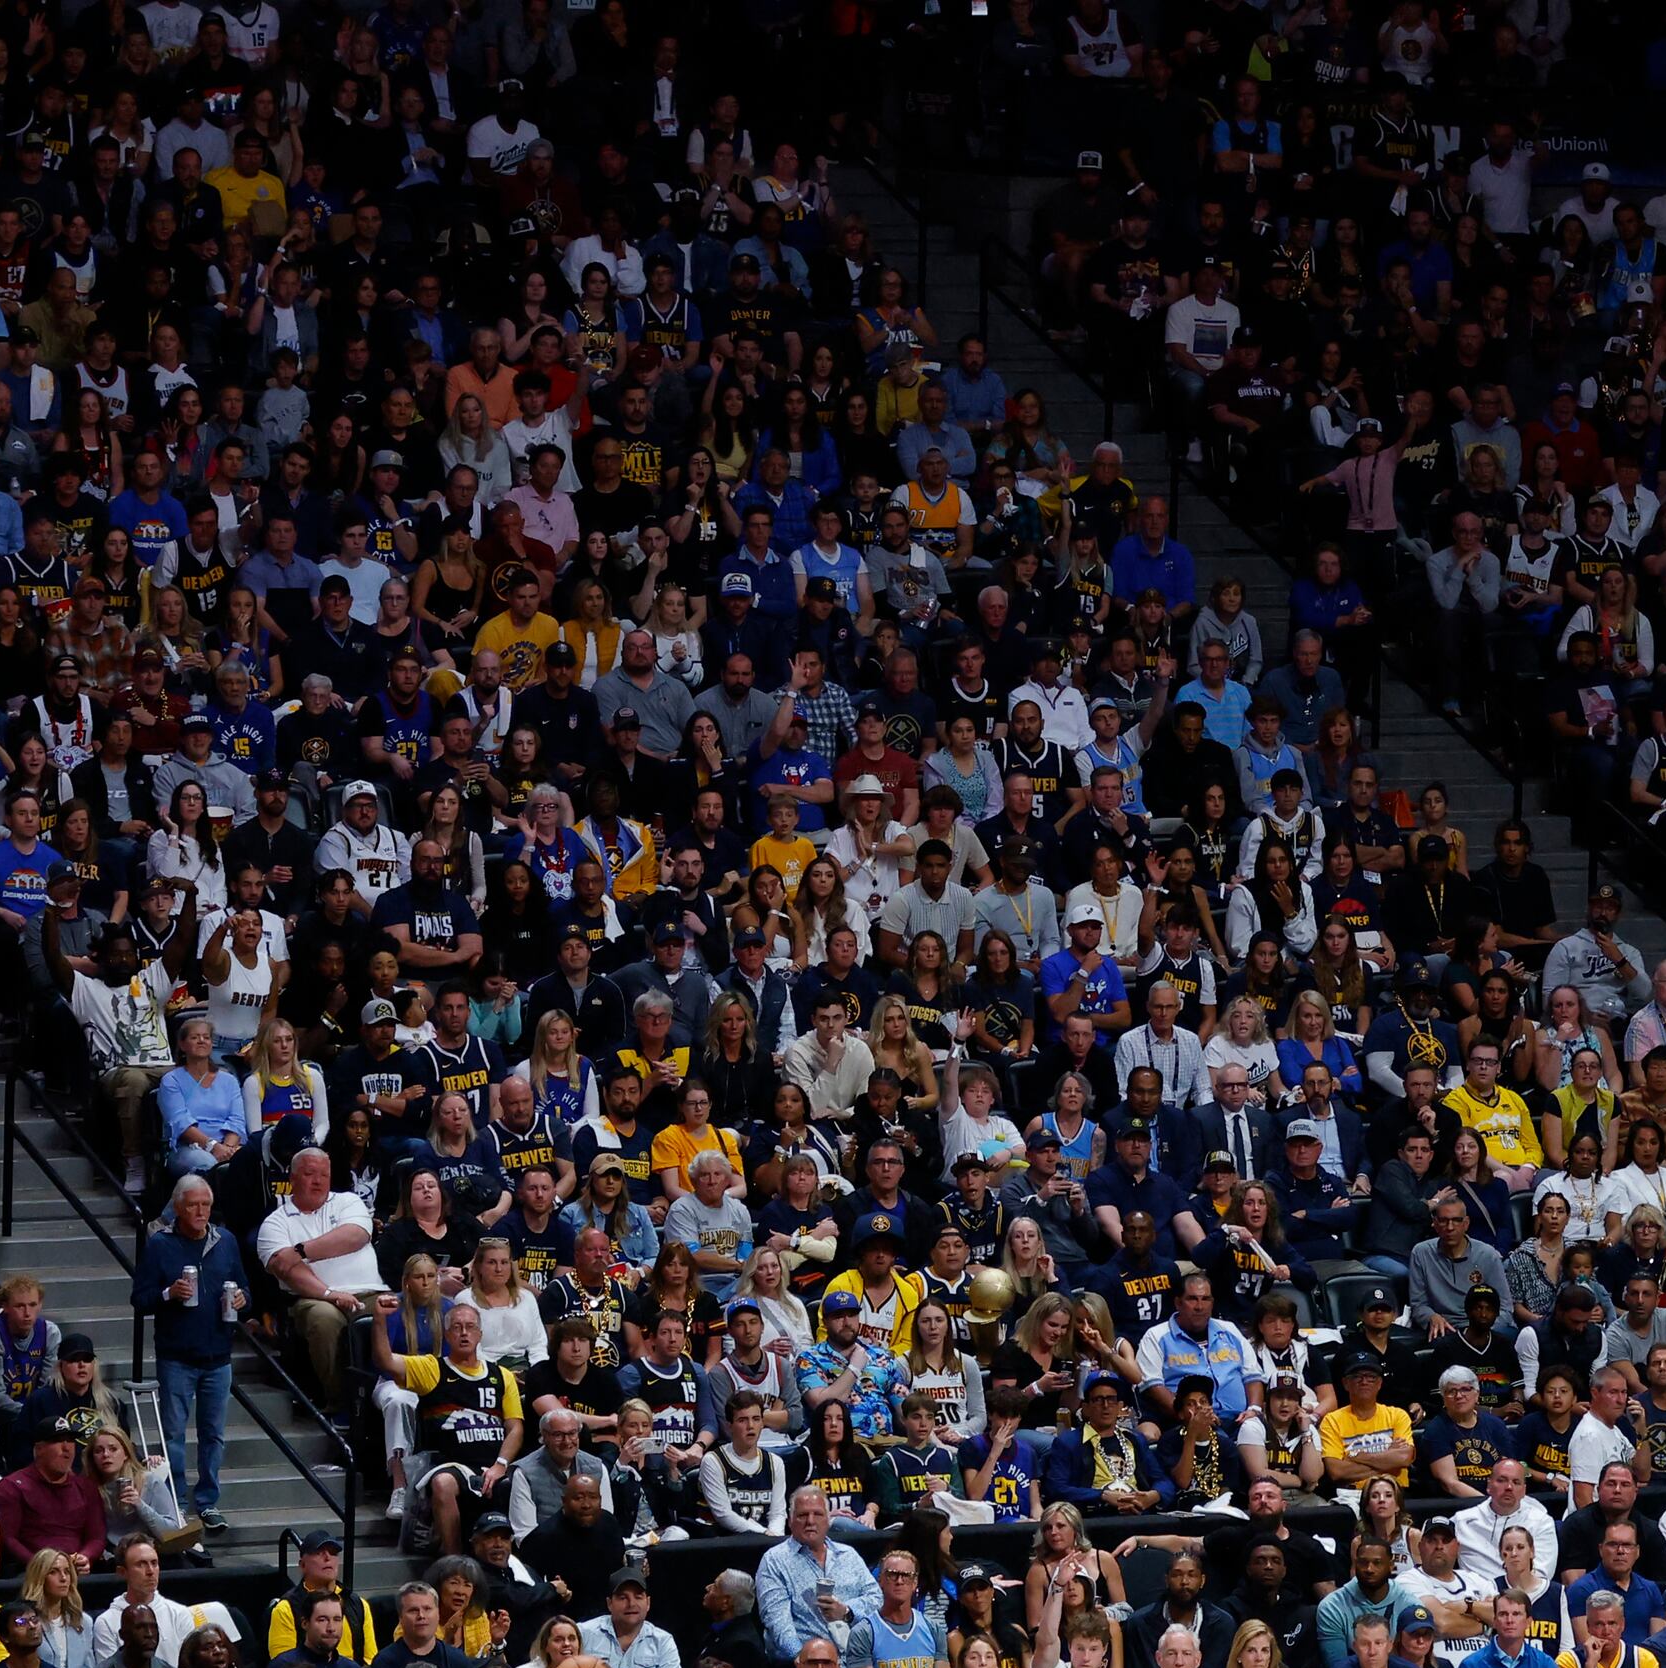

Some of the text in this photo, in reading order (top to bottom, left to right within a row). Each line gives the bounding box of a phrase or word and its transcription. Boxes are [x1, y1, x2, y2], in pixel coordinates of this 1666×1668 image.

[7, 266, 26, 283] 27
[622, 452, 662, 474] MILE
[909, 509, 926, 525] 27
[197, 589, 218, 612] 15
[73, 864, 101, 880] VER
[441, 1069, 490, 1092] DENVER
[290, 1093, 312, 1111] 55
[501, 1145, 555, 1170] DENVER
[623, 1158, 652, 1174] GGETS
[1235, 1275, 1264, 1298] 27
[1137, 1297, 1163, 1320] 27
[477, 1386, 498, 1409] 15
[681, 1379, 698, 1404] 15
[455, 1425, 507, 1444] NUGGETS
[994, 1476, 1020, 1504] 27
[1530, 1621, 1558, 1641] VER
